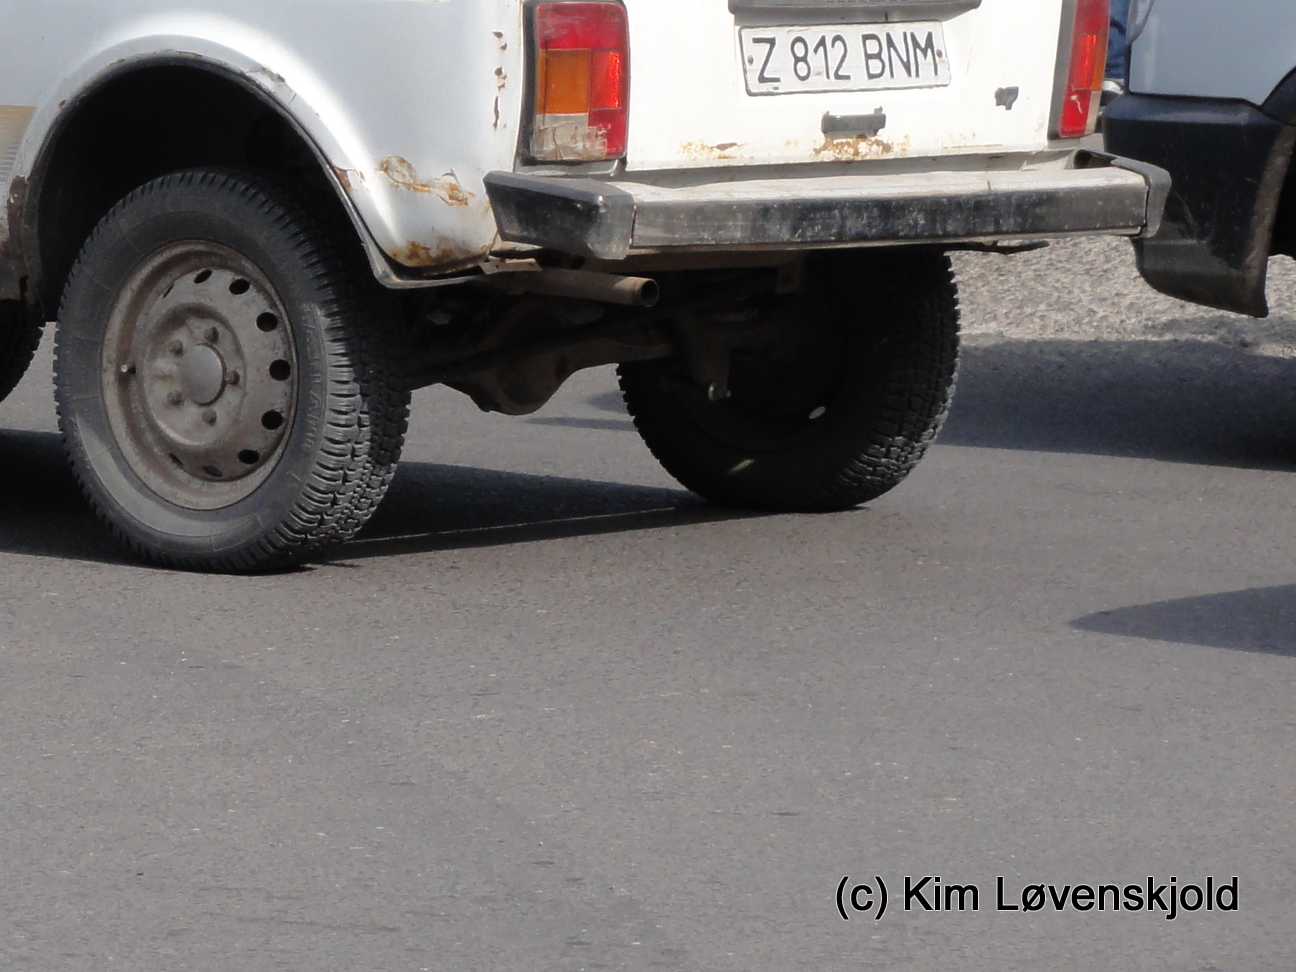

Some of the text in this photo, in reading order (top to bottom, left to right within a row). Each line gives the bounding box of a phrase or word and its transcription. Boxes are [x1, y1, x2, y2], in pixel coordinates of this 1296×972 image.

[752, 31, 939, 83] Z 812 BNM
